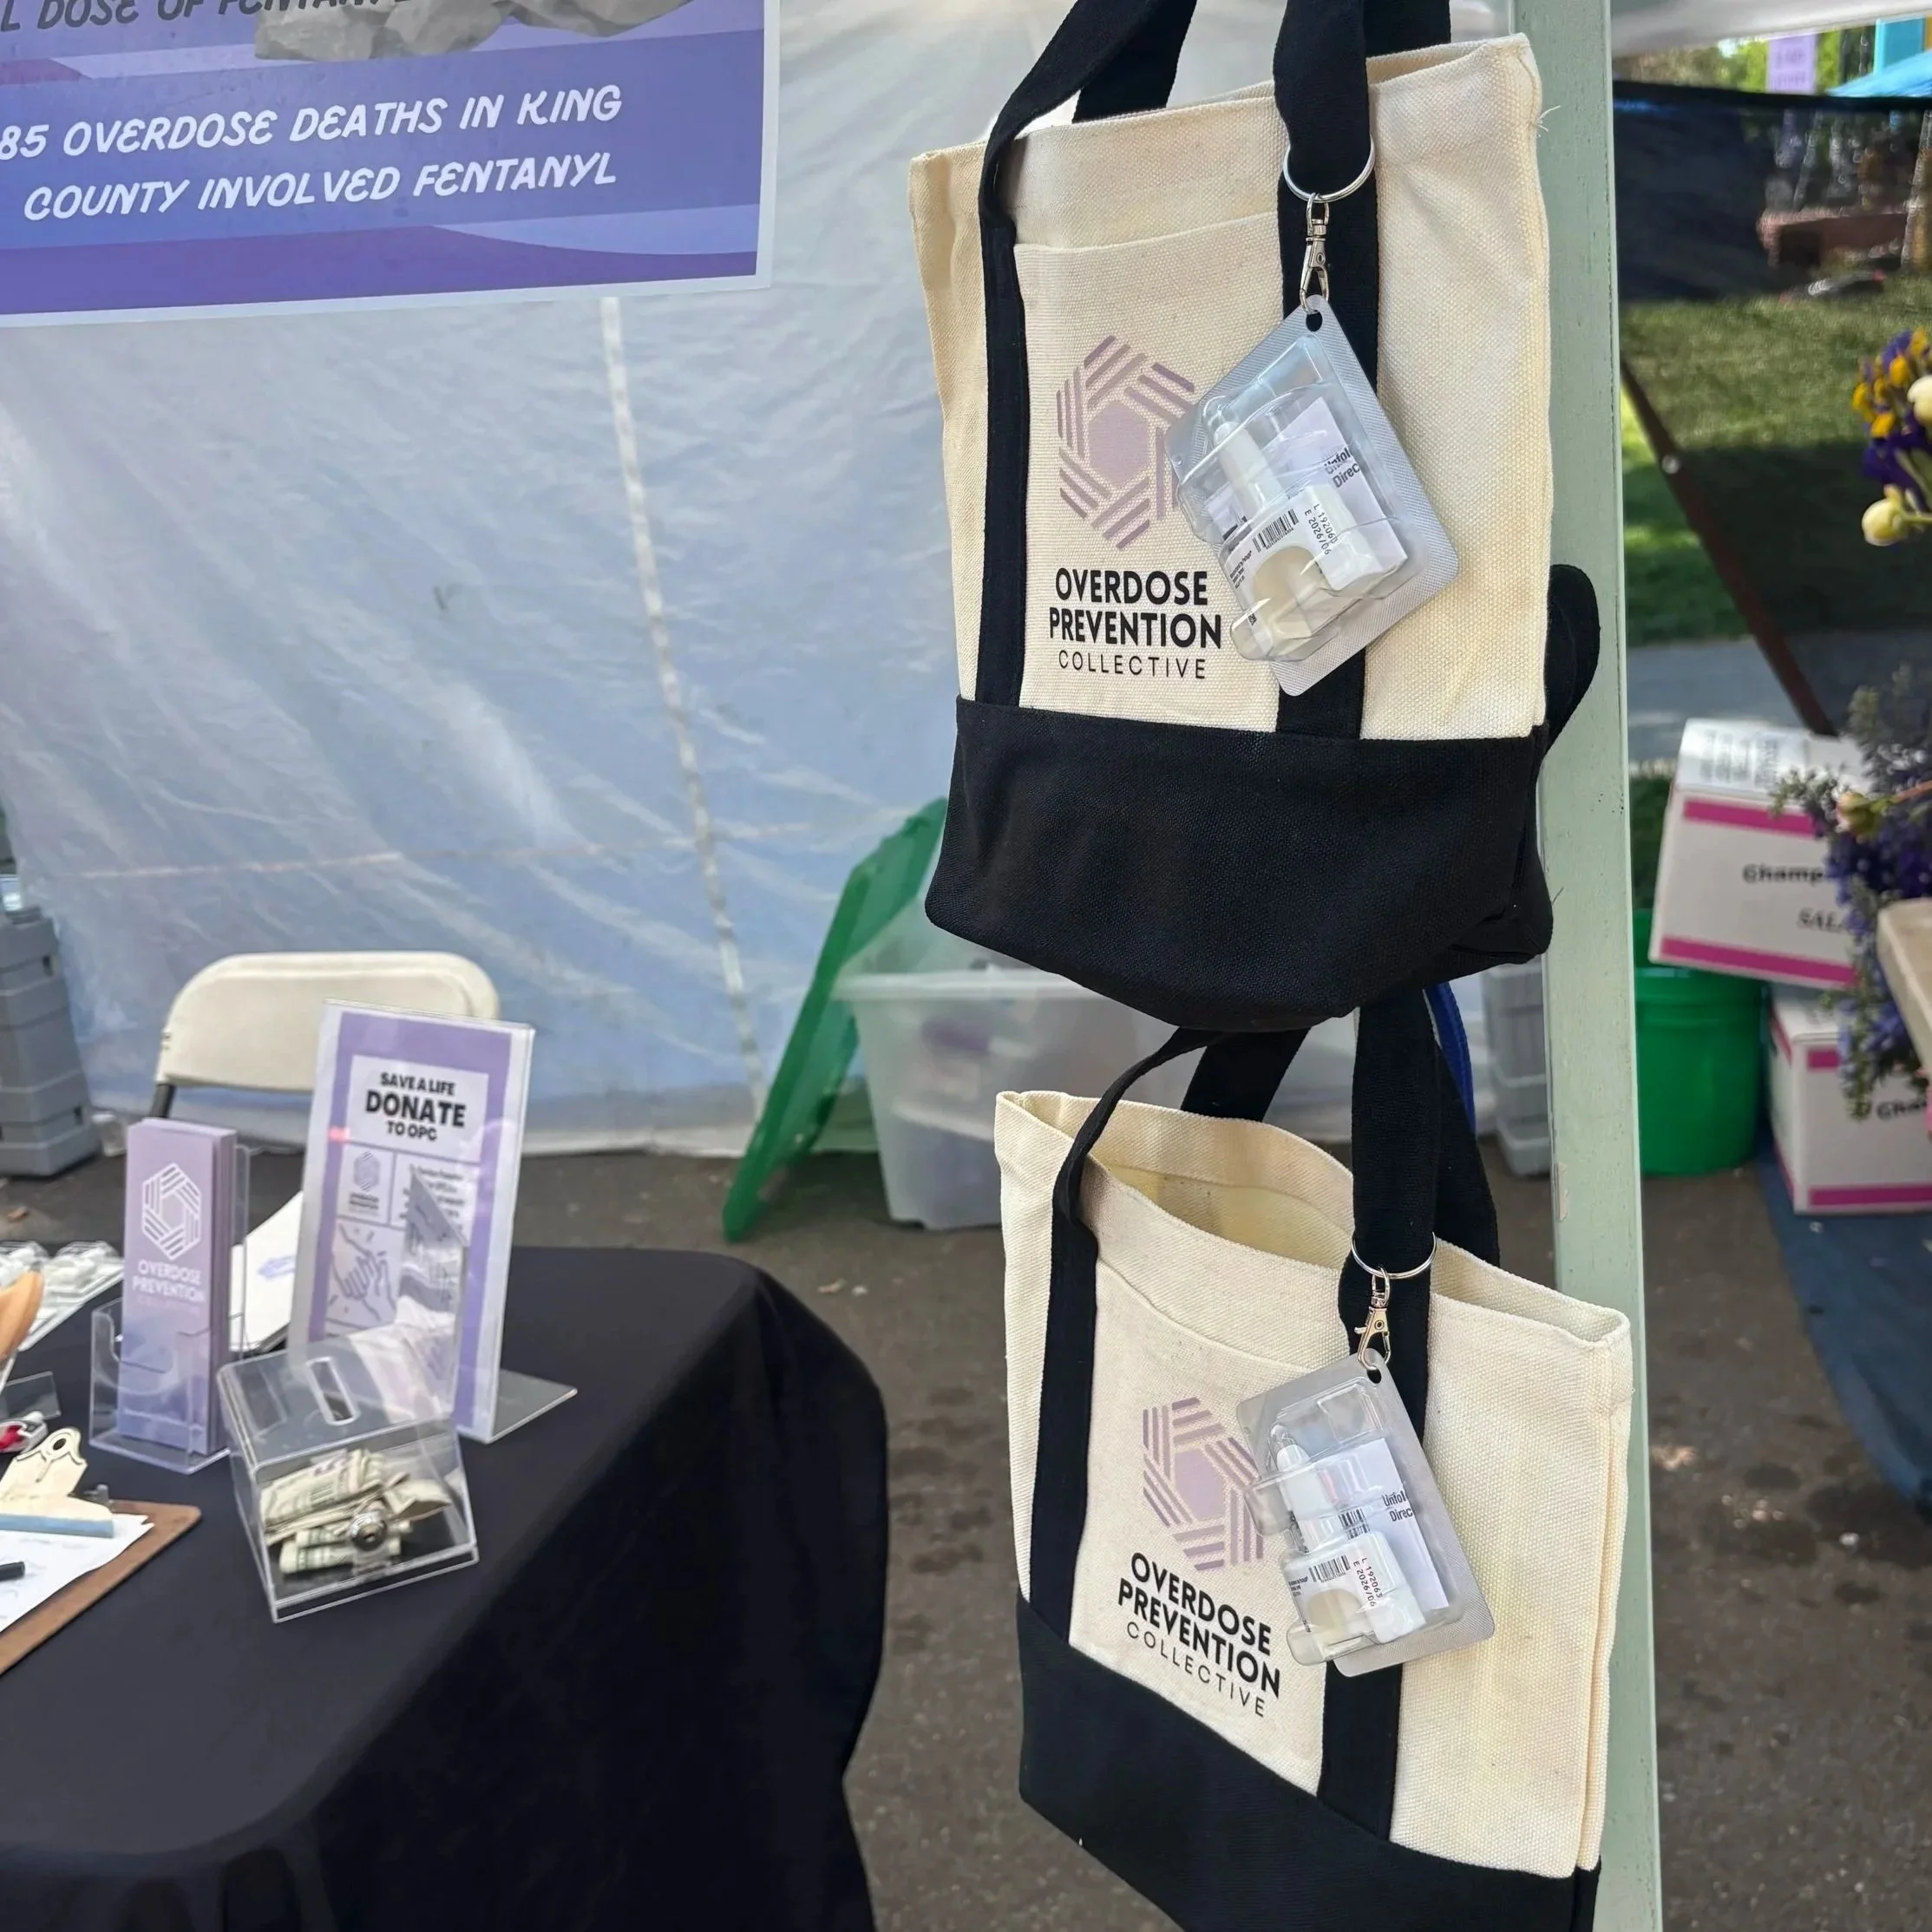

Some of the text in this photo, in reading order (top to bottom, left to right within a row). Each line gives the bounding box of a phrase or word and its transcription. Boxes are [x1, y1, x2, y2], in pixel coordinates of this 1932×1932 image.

[37, 0, 139, 29] DOSE
[0, 85, 621, 160] 85 OVERDOSE DEATHS IN KING
[23, 152, 617, 221] COUNTY INVOLVED FENTANYL
[1308, 517, 1333, 555] 2026/06
[1056, 567, 1208, 606] OVERDOSE
[1050, 606, 1221, 649] PREVENTION
[1058, 650, 1205, 678] COLLECTIVE
[380, 1071, 455, 1096] SAVE A LIFE
[365, 1089, 466, 1128] DONATE
[386, 1121, 437, 1141] TO OPC
[132, 1275, 206, 1302] PREVENTION
[138, 1259, 202, 1287] OVERDOSE
[1131, 1552, 1271, 1656] OVERDOSE
[1357, 1569, 1377, 1607] 2026/06
[1118, 1577, 1280, 1700] PREVENTION
[1127, 1621, 1265, 1717] COLLECTIVE
